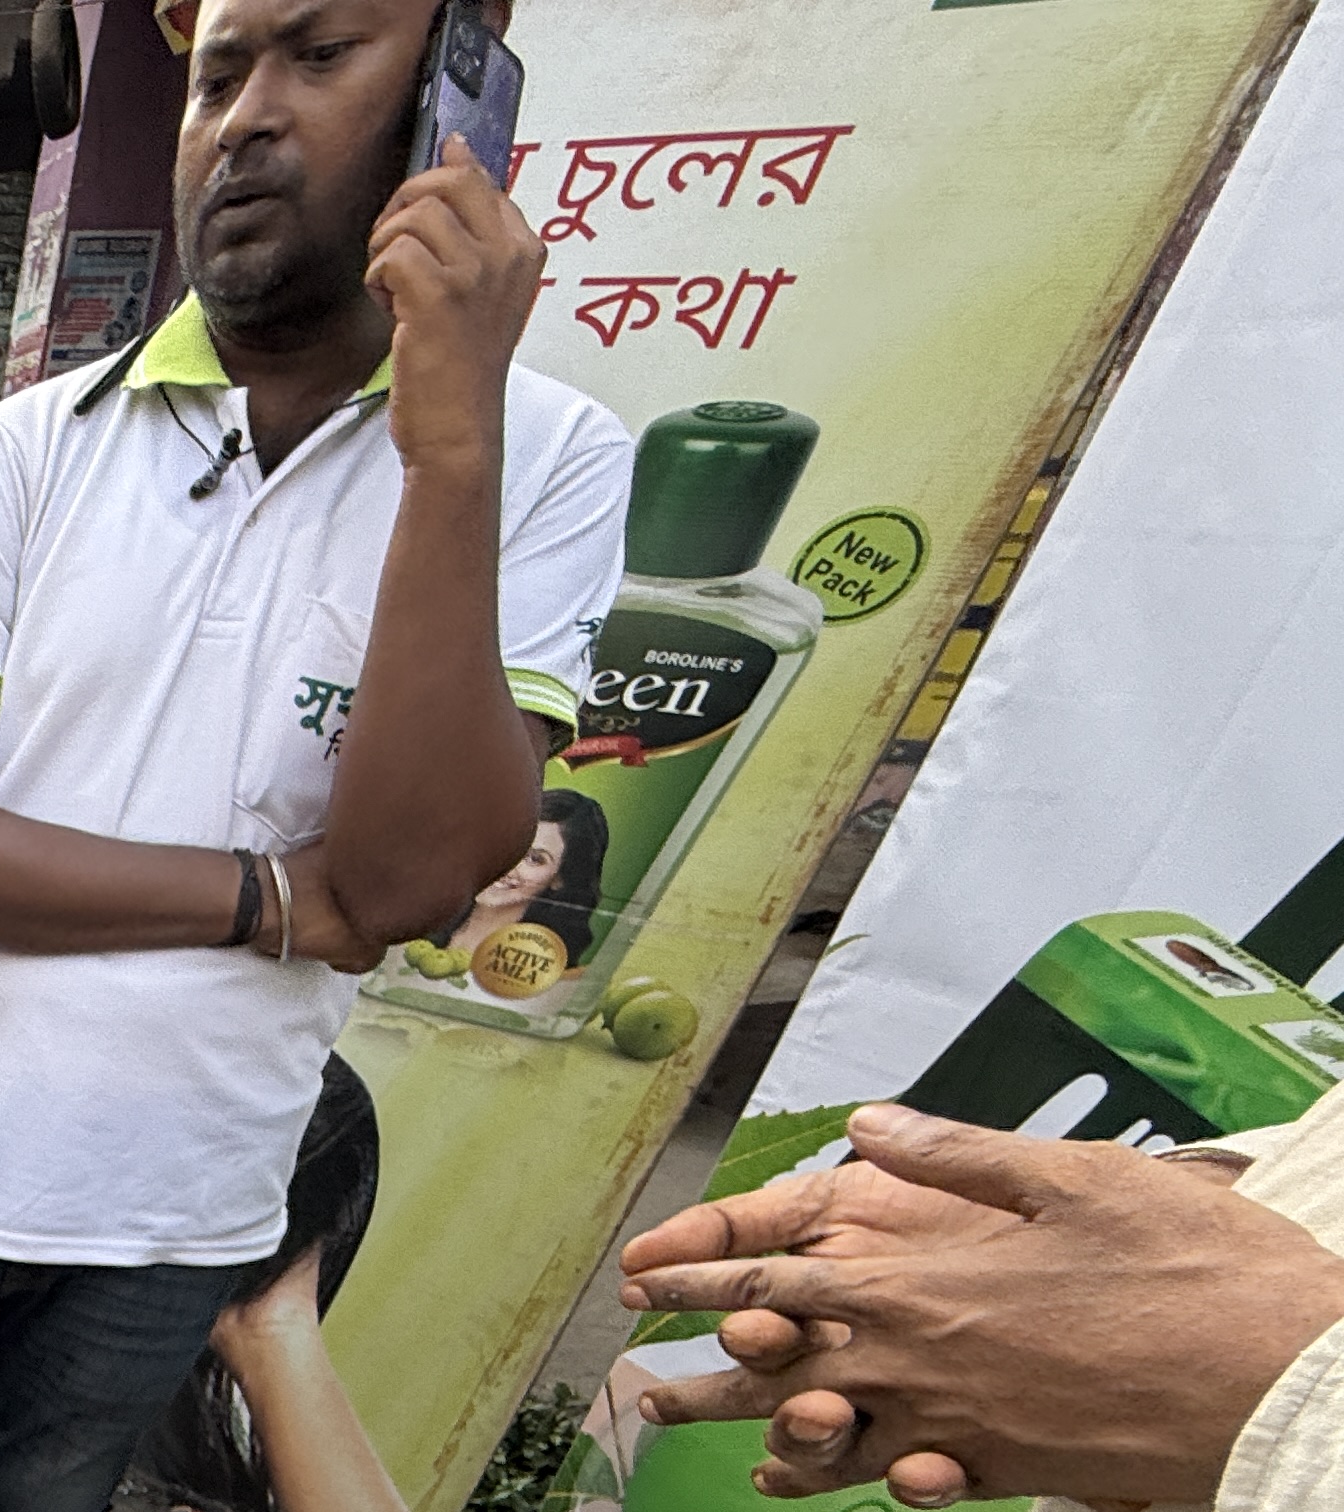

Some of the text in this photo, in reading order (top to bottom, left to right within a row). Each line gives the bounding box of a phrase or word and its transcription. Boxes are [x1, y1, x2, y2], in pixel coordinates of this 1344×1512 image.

[540, 125, 855, 242] চুলের
[574, 268, 797, 349] কথা
[832, 530, 899, 574] New
[805, 558, 876, 606] Pack
[643, 649, 744, 674] BOROLINE'S
[585, 668, 710, 718] een
